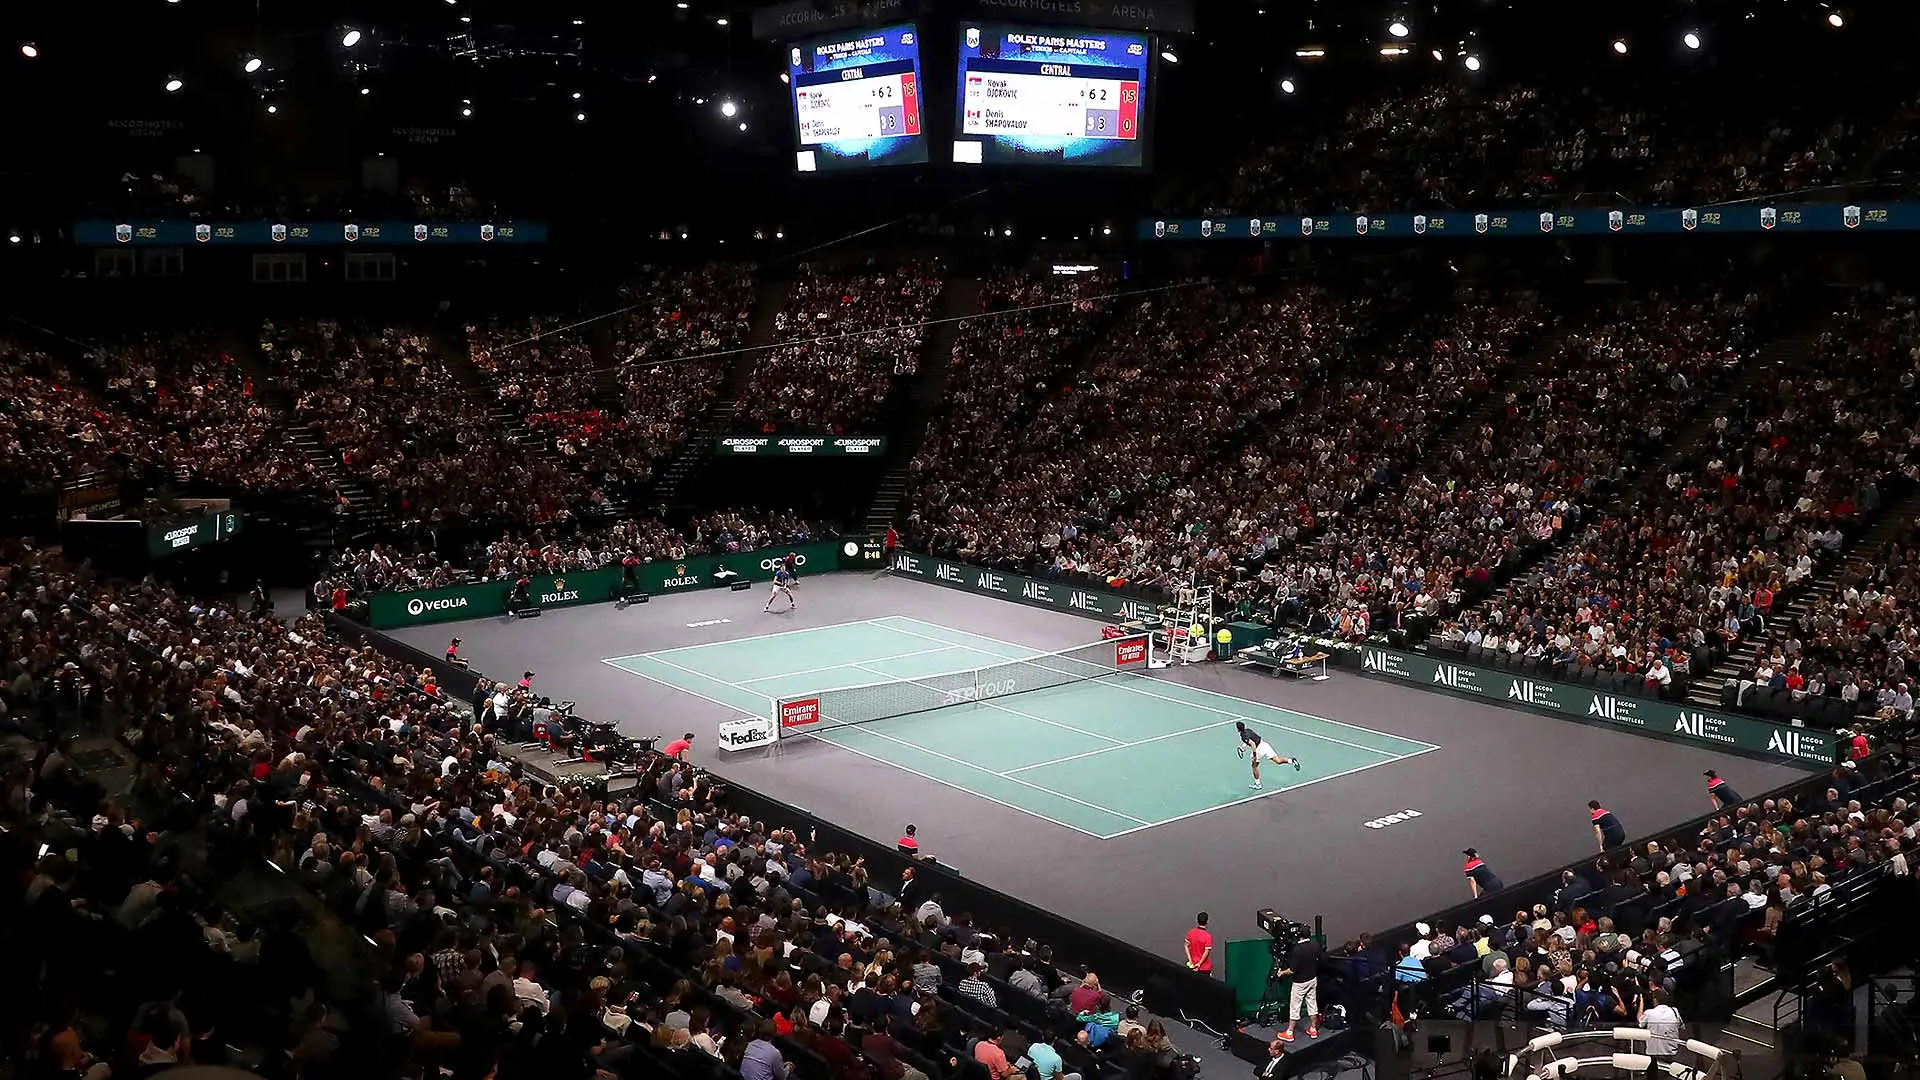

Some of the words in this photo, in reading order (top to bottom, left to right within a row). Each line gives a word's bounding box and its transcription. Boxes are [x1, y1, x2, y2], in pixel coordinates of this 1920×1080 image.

[1112, 5, 1155, 20] ARENA
[816, 44, 837, 55] ROLEX
[856, 37, 884, 50] MASTERS
[1008, 34, 1037, 44] ROLEX
[1038, 36, 1066, 47] PARIS
[1066, 38, 1106, 50] MASTERS
[842, 68, 863, 80] CENTRAL
[1040, 64, 1072, 76] CENTRAL
[903, 82, 914, 96] 15
[1089, 89, 1096, 100] 6
[1100, 90, 1106, 100] 2
[1122, 90, 1136, 102] 15
[986, 109, 1004, 118] Denis
[889, 114, 896, 128] 3
[986, 120, 1028, 129] SHAPOVALOV
[1098, 118, 1105, 130] 3
[1124, 120, 1132, 131] 0
[166, 525, 198, 540] EUROSPORT
[664, 576, 698, 588] ROLEX
[542, 590, 578, 603] ROLEX
[424, 597, 468, 610] VEOLIA
[1119, 644, 1144, 655] Emirates
[980, 679, 1016, 698] TOUR
[1535, 699, 1561, 708] LIMITLESS
[784, 704, 817, 716] Emirates
[1617, 715, 1645, 725] LIMITLESS
[1705, 718, 1726, 726] ACCOR
[731, 729, 767, 745] FedEx
[1705, 733, 1735, 743] LIMITLESS
[1801, 736, 1824, 745] ACCOR
[1801, 752, 1833, 762] LIMITLESS
[1363, 808, 1423, 829] PARIS
